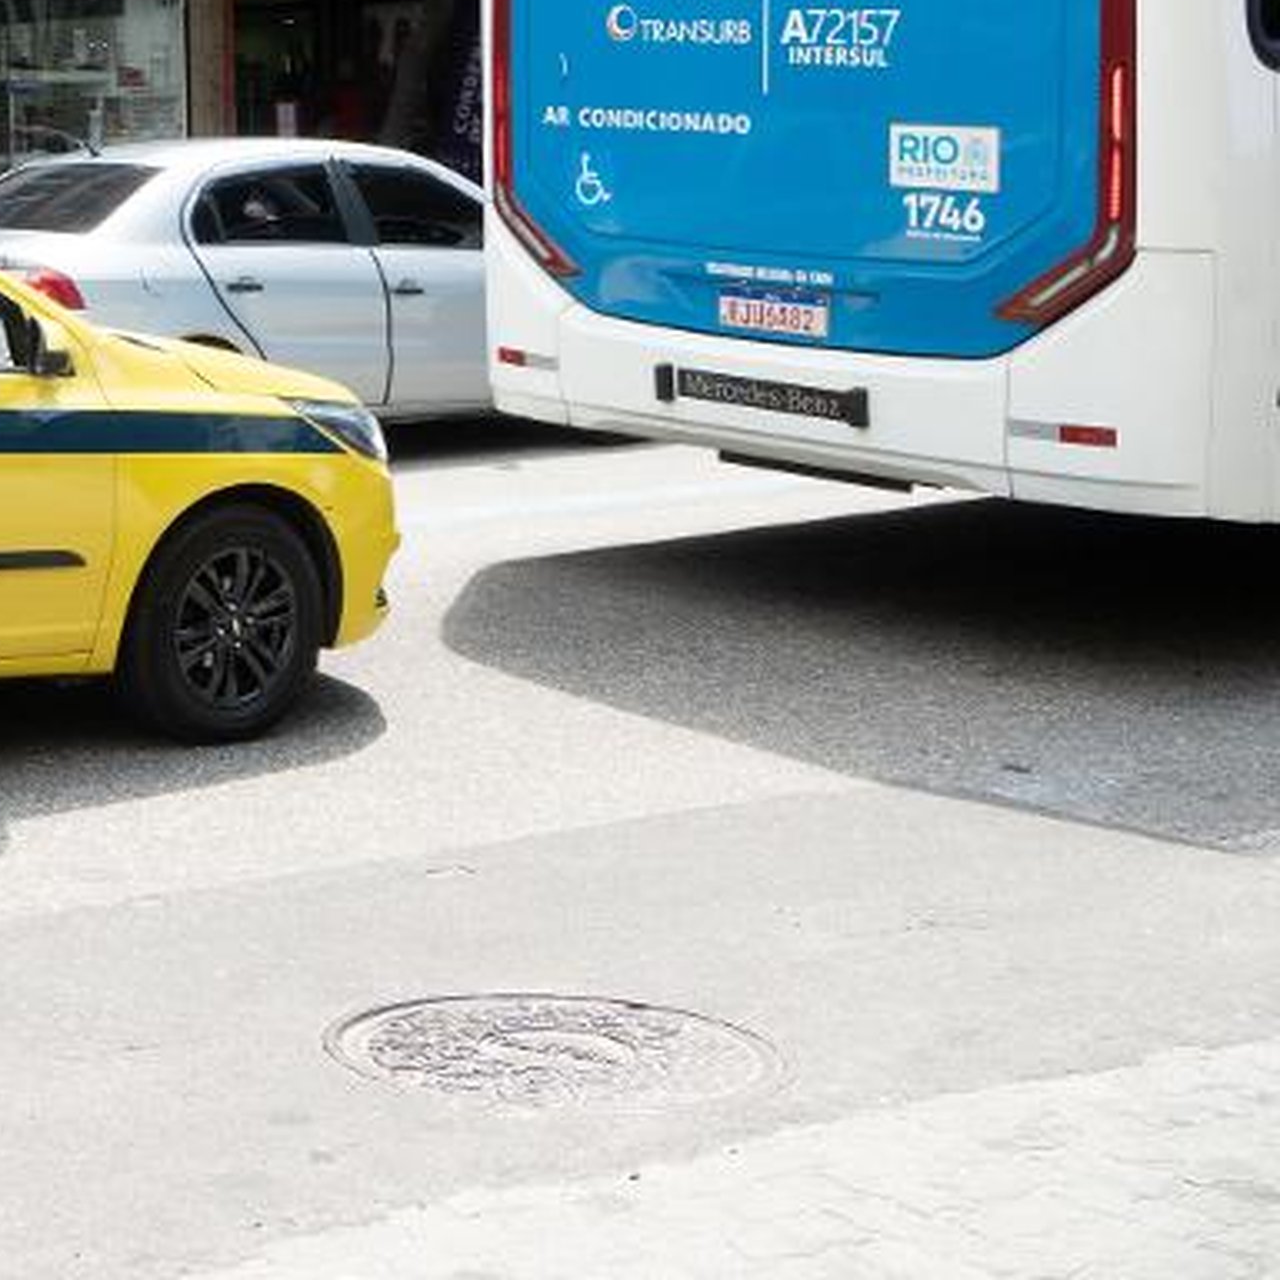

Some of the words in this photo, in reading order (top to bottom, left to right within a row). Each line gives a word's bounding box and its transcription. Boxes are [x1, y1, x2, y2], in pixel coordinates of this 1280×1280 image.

[639, 18, 752, 45] TRANSURB
[780, 8, 902, 46] A72157
[788, 46, 890, 68] INTERSUL
[542, 106, 571, 127] AR
[578, 107, 752, 135] CONDICIONADO
[899, 135, 959, 165] RIO
[903, 193, 986, 233] 1746
